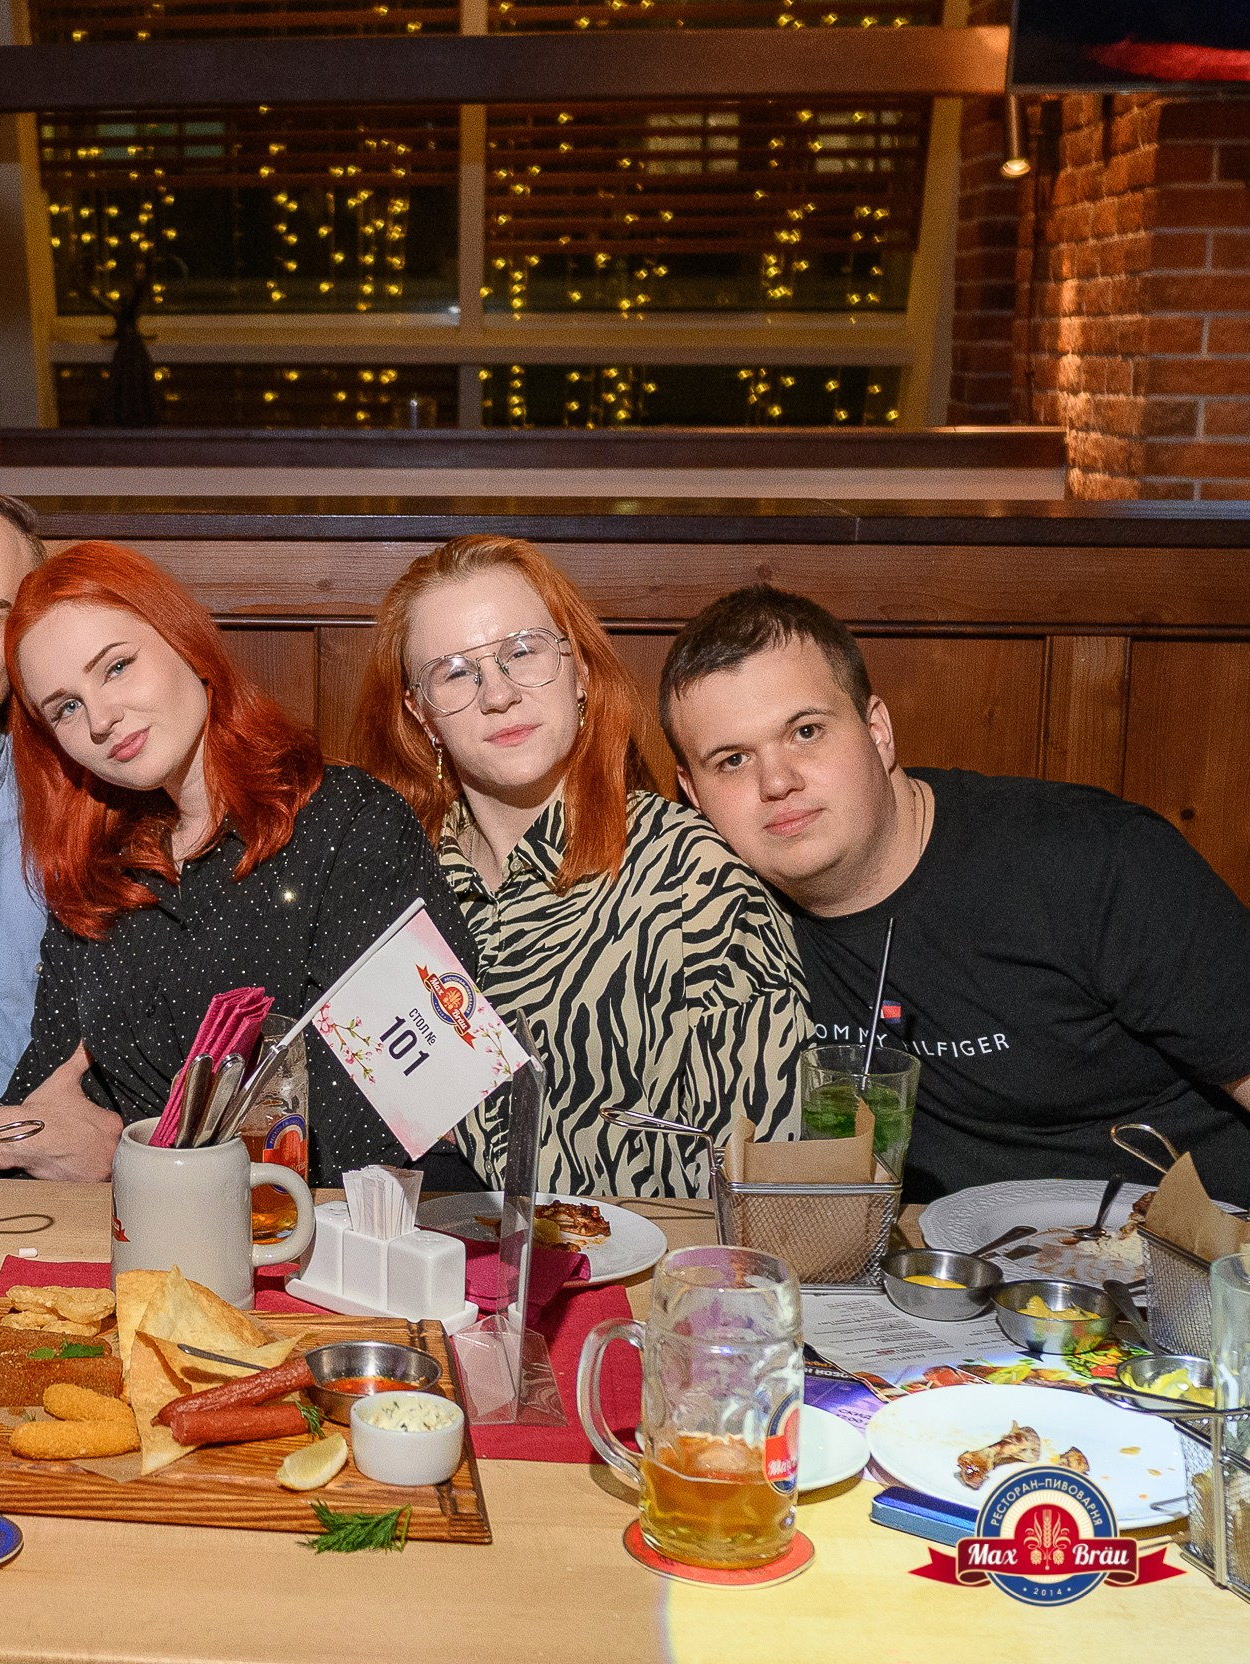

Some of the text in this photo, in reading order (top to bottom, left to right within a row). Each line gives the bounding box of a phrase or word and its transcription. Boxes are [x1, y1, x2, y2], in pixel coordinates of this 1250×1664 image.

[430, 977, 444, 996] Max
[408, 1008, 437, 1046] СТОЛ №
[814, 1023, 888, 1048] OMMY
[379, 1015, 430, 1077] 101
